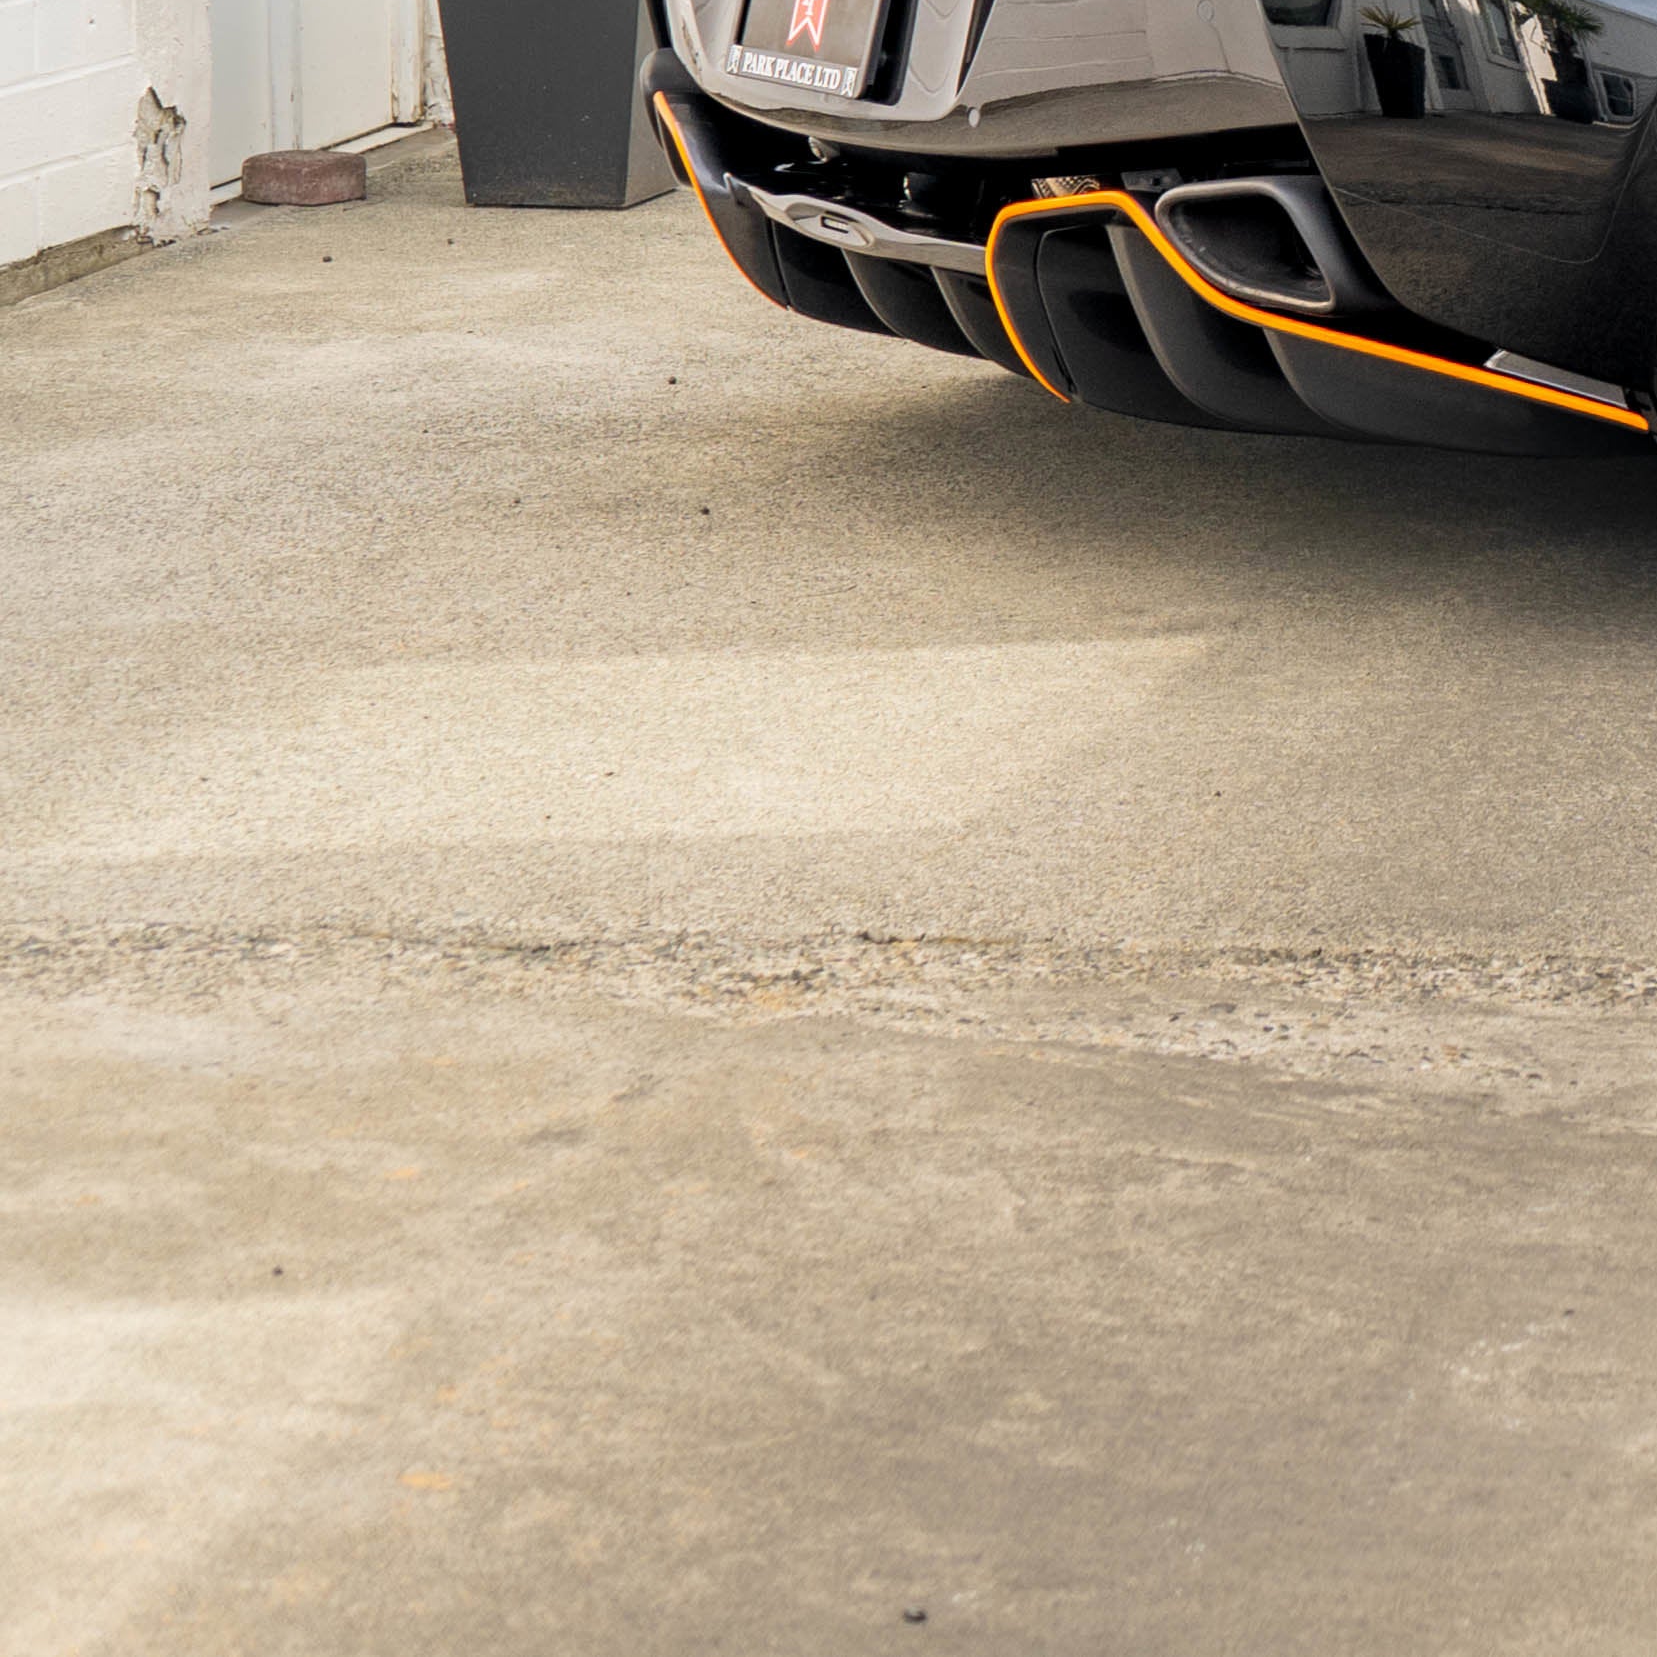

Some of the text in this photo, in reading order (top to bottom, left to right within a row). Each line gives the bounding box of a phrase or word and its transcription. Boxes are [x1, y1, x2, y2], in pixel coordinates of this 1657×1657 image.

[742, 52, 776, 78] PARK
[775, 57, 816, 85] PLACE
[813, 65, 842, 91] LTD
